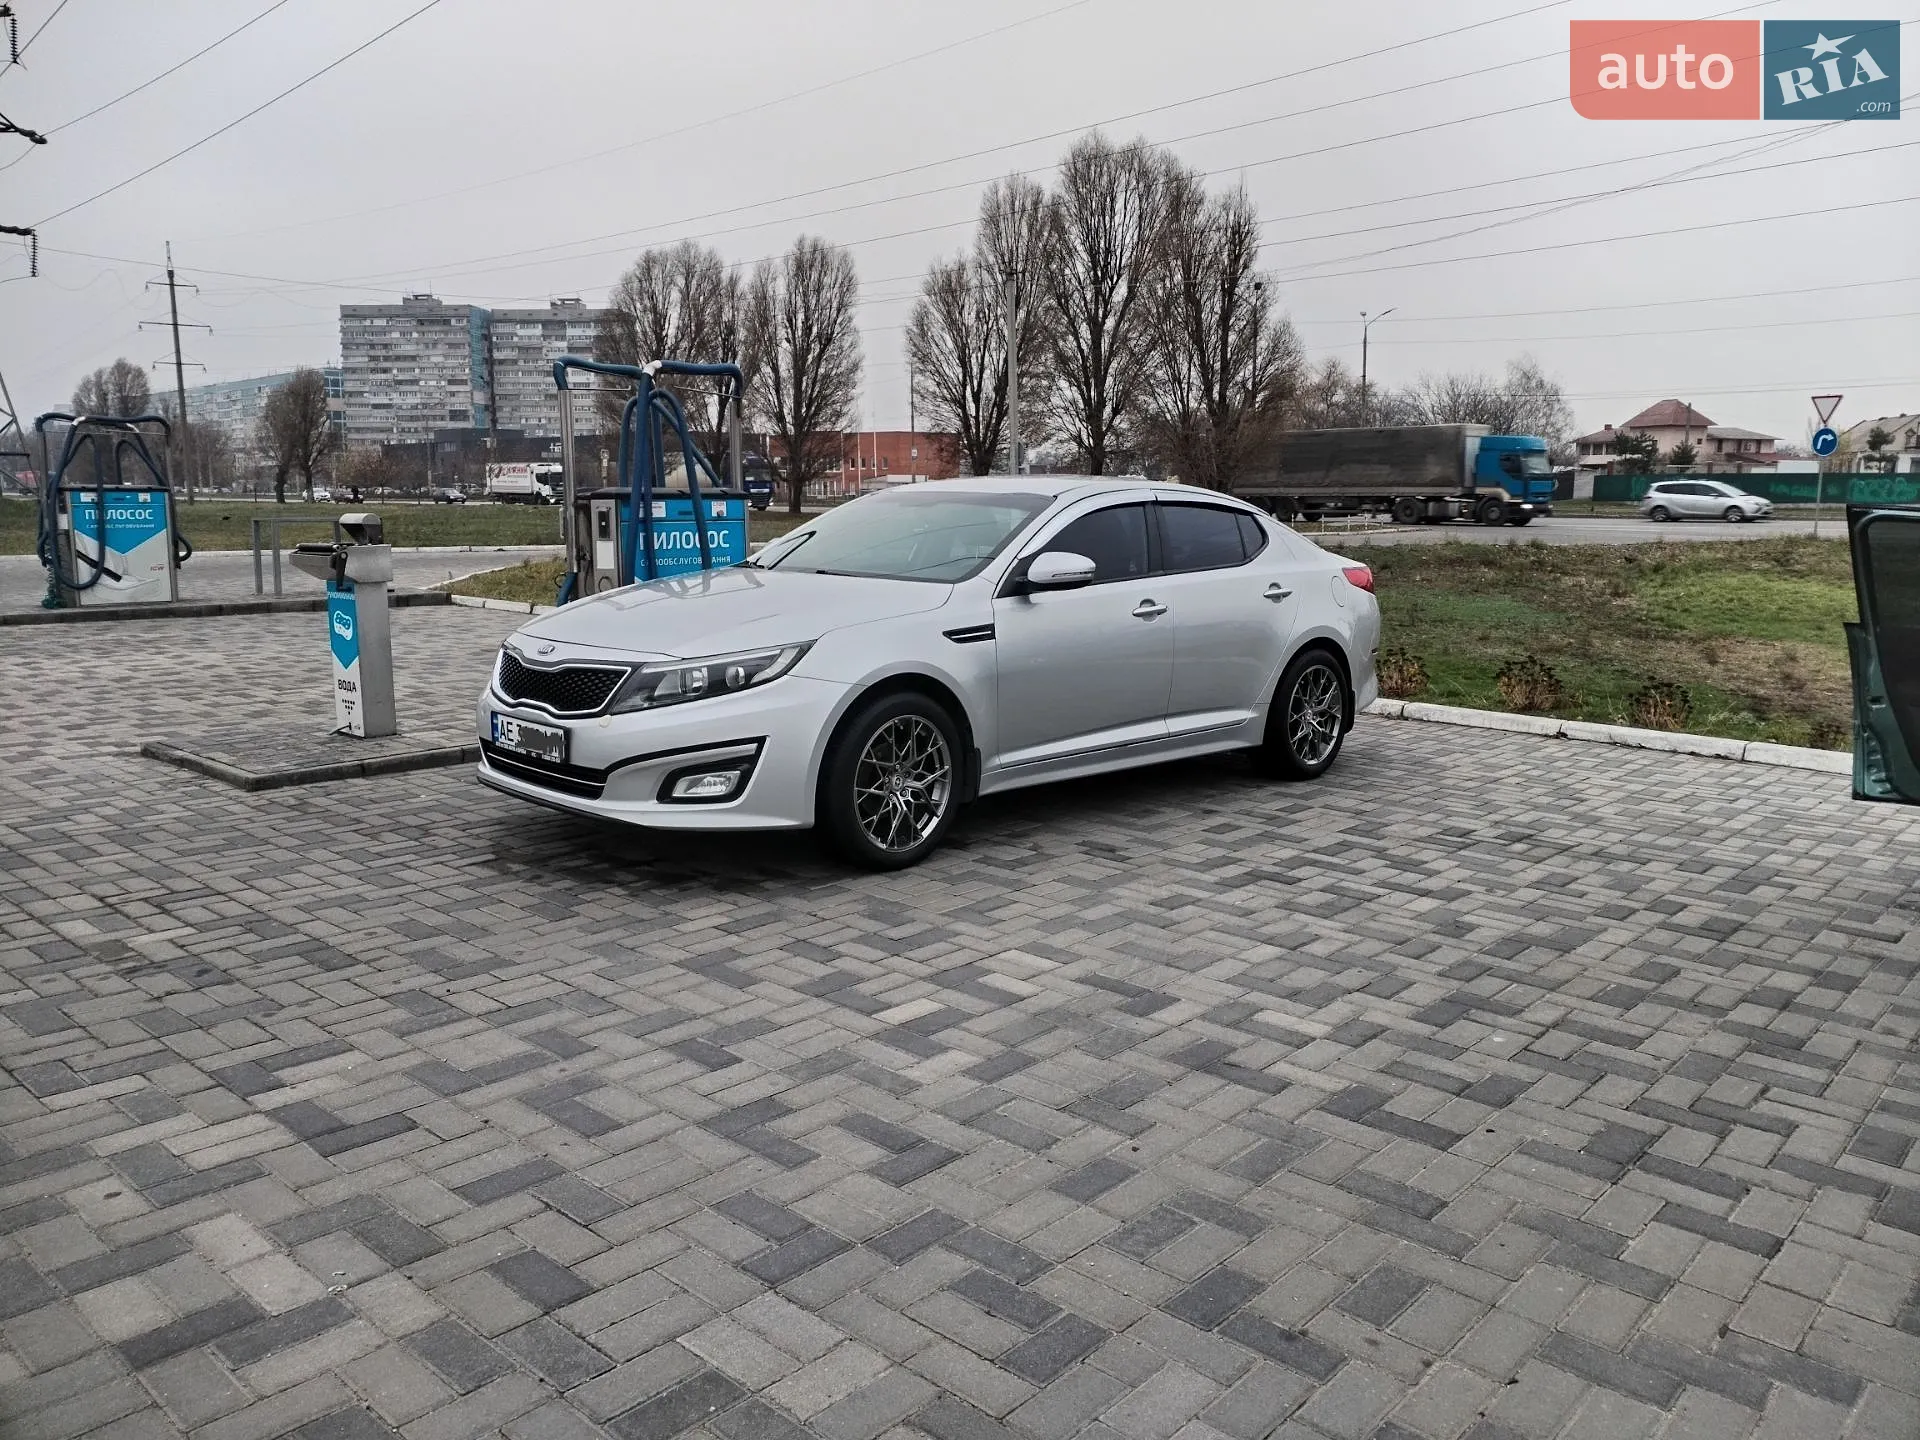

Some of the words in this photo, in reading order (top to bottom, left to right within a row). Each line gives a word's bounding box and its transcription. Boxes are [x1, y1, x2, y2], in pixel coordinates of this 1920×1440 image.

[84, 509, 154, 520] ПЛОСОС
[640, 555, 731, 567] СООБСЛУГОВАННЯ
[337, 679, 357, 693] ВОДА
